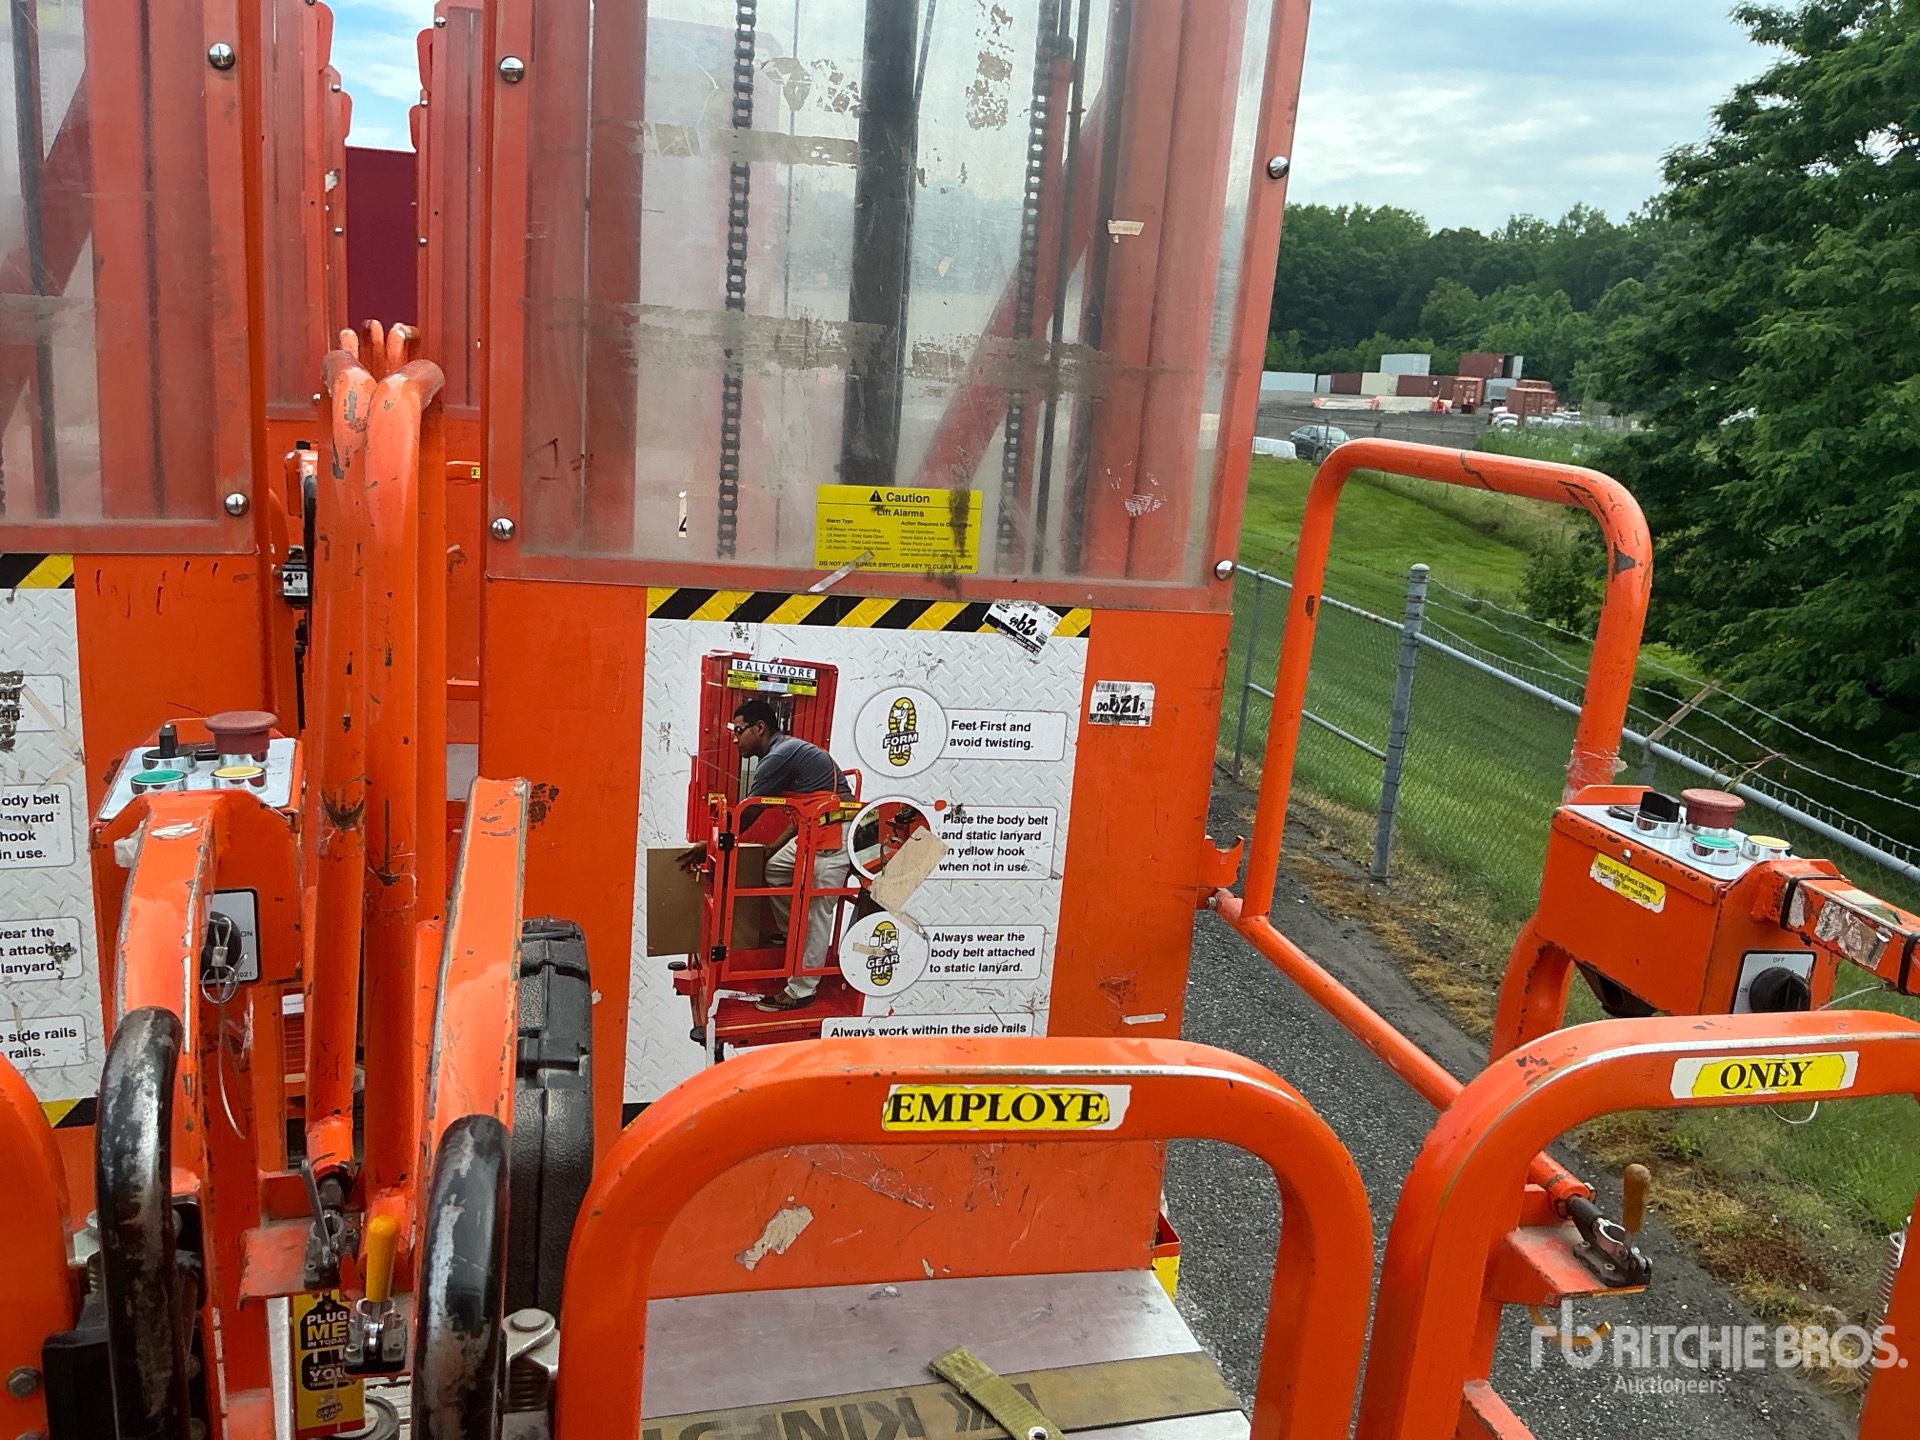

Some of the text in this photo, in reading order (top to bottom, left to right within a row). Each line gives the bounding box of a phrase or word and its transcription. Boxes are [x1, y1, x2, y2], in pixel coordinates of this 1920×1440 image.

[886, 491, 930, 504] Caution
[876, 508, 925, 518] Lift Alarms
[736, 660, 813, 678] BALLYMORE
[951, 720, 1031, 732] Feet First and
[883, 733, 918, 748] FORM
[949, 736, 1034, 751] avoid twisting.
[893, 744, 910, 755] UP
[33, 793, 60, 805] belt
[943, 814, 1048, 827] Place the body belt
[0, 830, 37, 842] hook
[941, 830, 1042, 843] and static lanyard
[16, 849, 47, 859] use.
[958, 846, 994, 858] yellow
[997, 847, 1025, 856] hook
[938, 862, 1031, 872] when not in use.
[30, 927, 55, 937] the
[240, 930, 253, 938] ON
[932, 932, 1025, 944] Always wear the
[9, 942, 72, 957] attached
[930, 947, 1036, 960] body belt attached
[867, 954, 899, 968] GEAR
[929, 962, 1023, 974] to static lanyard.
[8, 1029, 41, 1043] side
[44, 1027, 78, 1040] rails
[830, 1022, 1027, 1038] Always work within the side rails
[8, 1048, 46, 1059] rails.
[1719, 1061, 1813, 1090] ONLY
[886, 1092, 1111, 1123] EMPLOYE
[306, 1310, 348, 1325] PLUG
[307, 1320, 347, 1342] ME
[307, 1340, 317, 1348] IN
